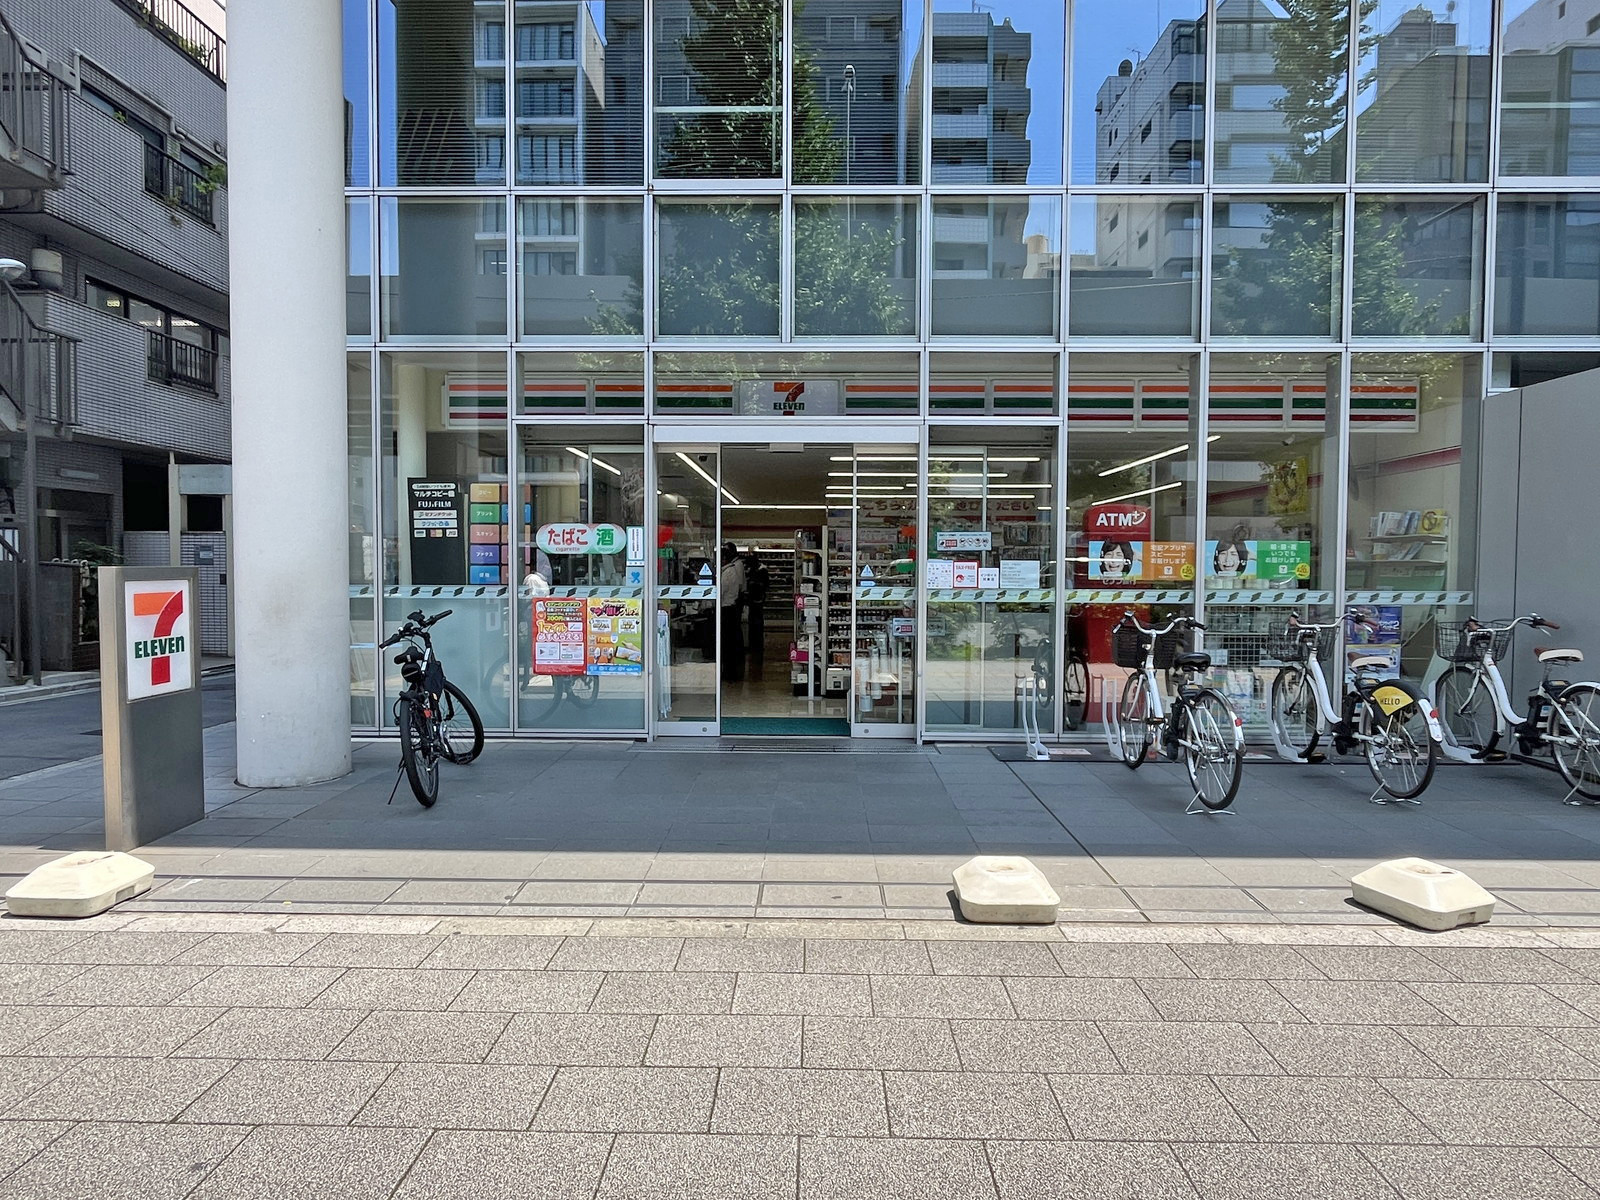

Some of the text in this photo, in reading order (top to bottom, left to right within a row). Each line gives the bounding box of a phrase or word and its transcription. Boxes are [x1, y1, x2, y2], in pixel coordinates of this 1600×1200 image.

[774, 382, 804, 416] 7
[1096, 513, 1132, 527] ATM
[548, 528, 588, 546] たばこ
[596, 528, 614, 546] 酒
[133, 590, 183, 685] 7
[1379, 698, 1401, 706] HELLO
